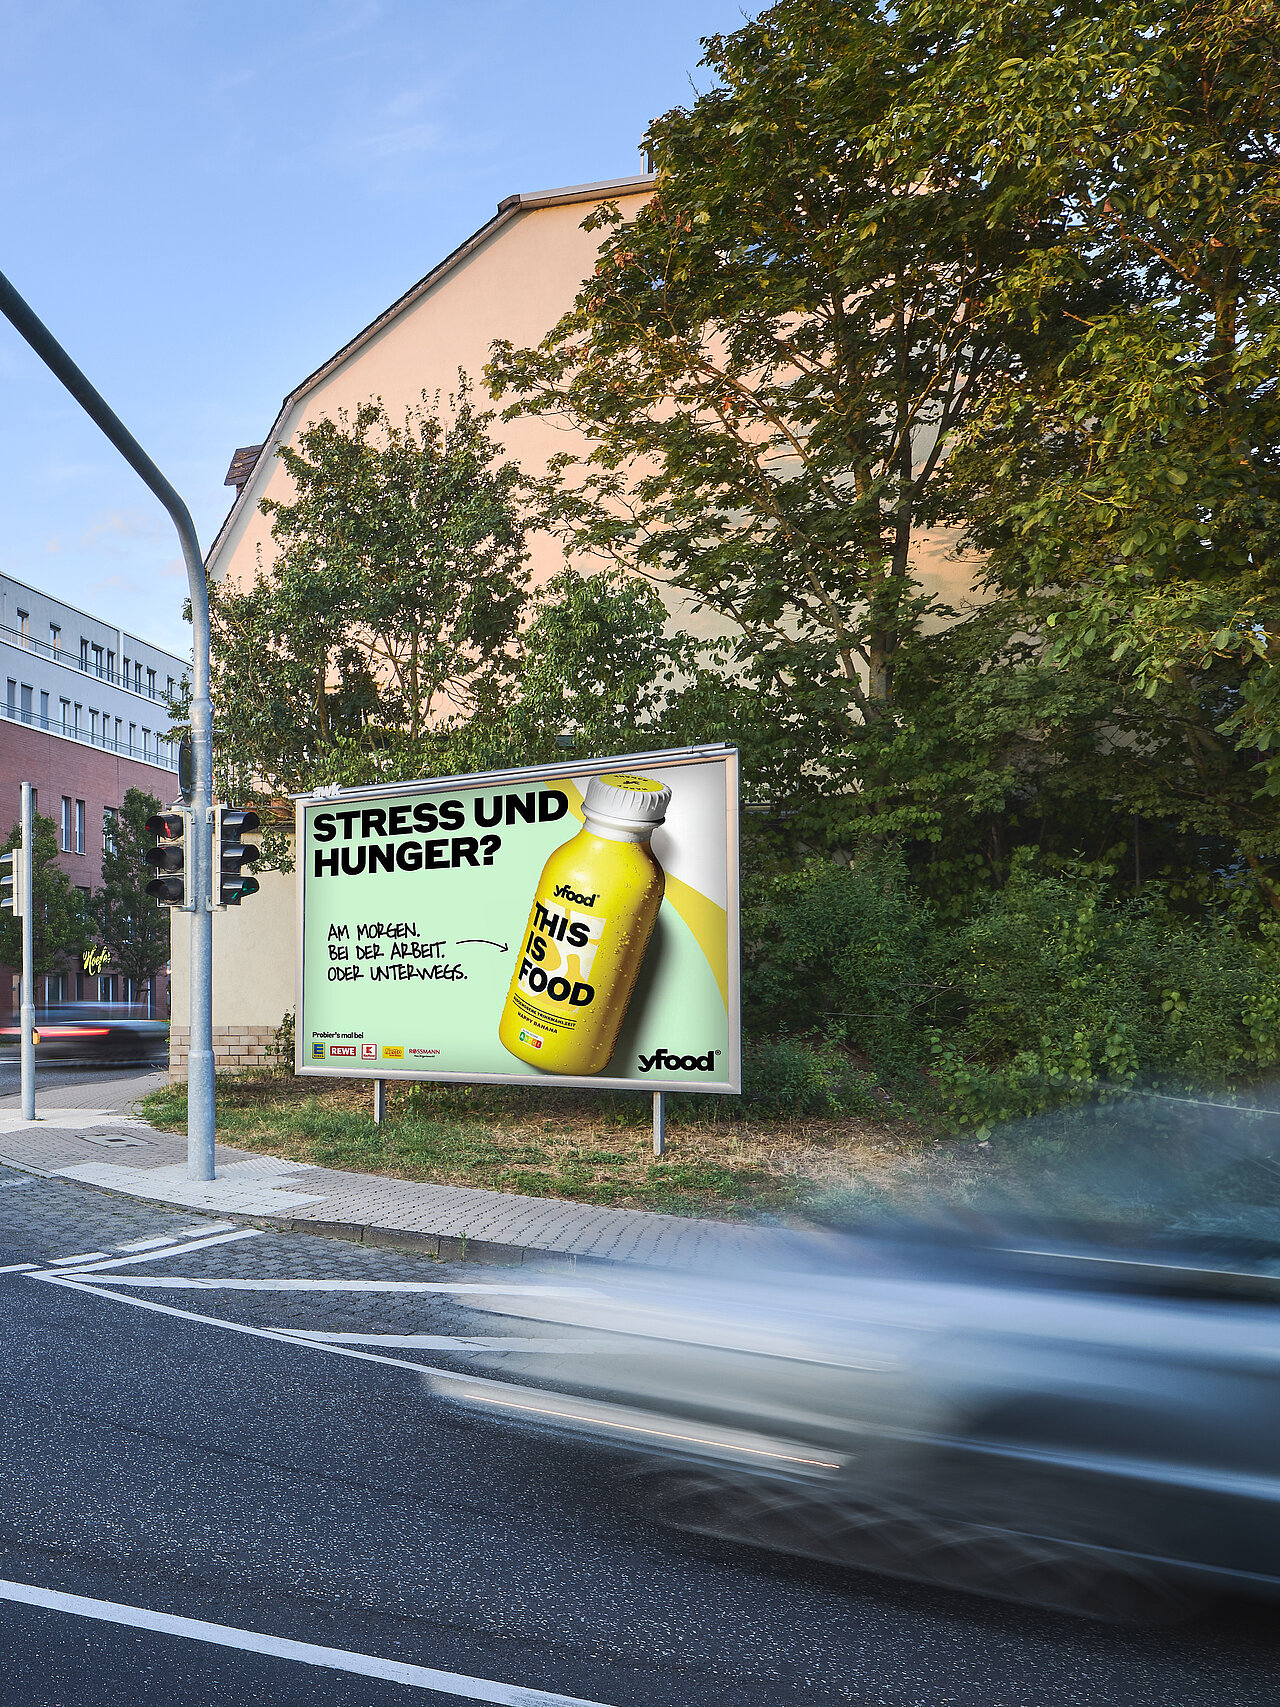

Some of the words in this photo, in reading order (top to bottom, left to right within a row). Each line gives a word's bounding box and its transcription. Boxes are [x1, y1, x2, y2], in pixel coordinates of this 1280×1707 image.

[312, 781, 341, 800] awk
[313, 800, 465, 843] STRESS
[474, 790, 569, 828] UND
[314, 834, 502, 878] HUNGER?
[328, 923, 350, 941] AM
[357, 922, 420, 941] MORGEN.
[533, 900, 591, 947] THIS
[328, 944, 349, 960] BEI
[356, 943, 385, 960] DER
[390, 941, 447, 960] ARBEIT.
[525, 930, 548, 961] IS
[327, 964, 365, 981] ODER
[370, 963, 468, 981] UNTERWEGS.
[518, 956, 596, 1007] FOOD
[312, 1031, 340, 1039] Probier's
[341, 1031, 354, 1039] mal
[354, 1031, 364, 1039] bei
[331, 1047, 355, 1055] REWE
